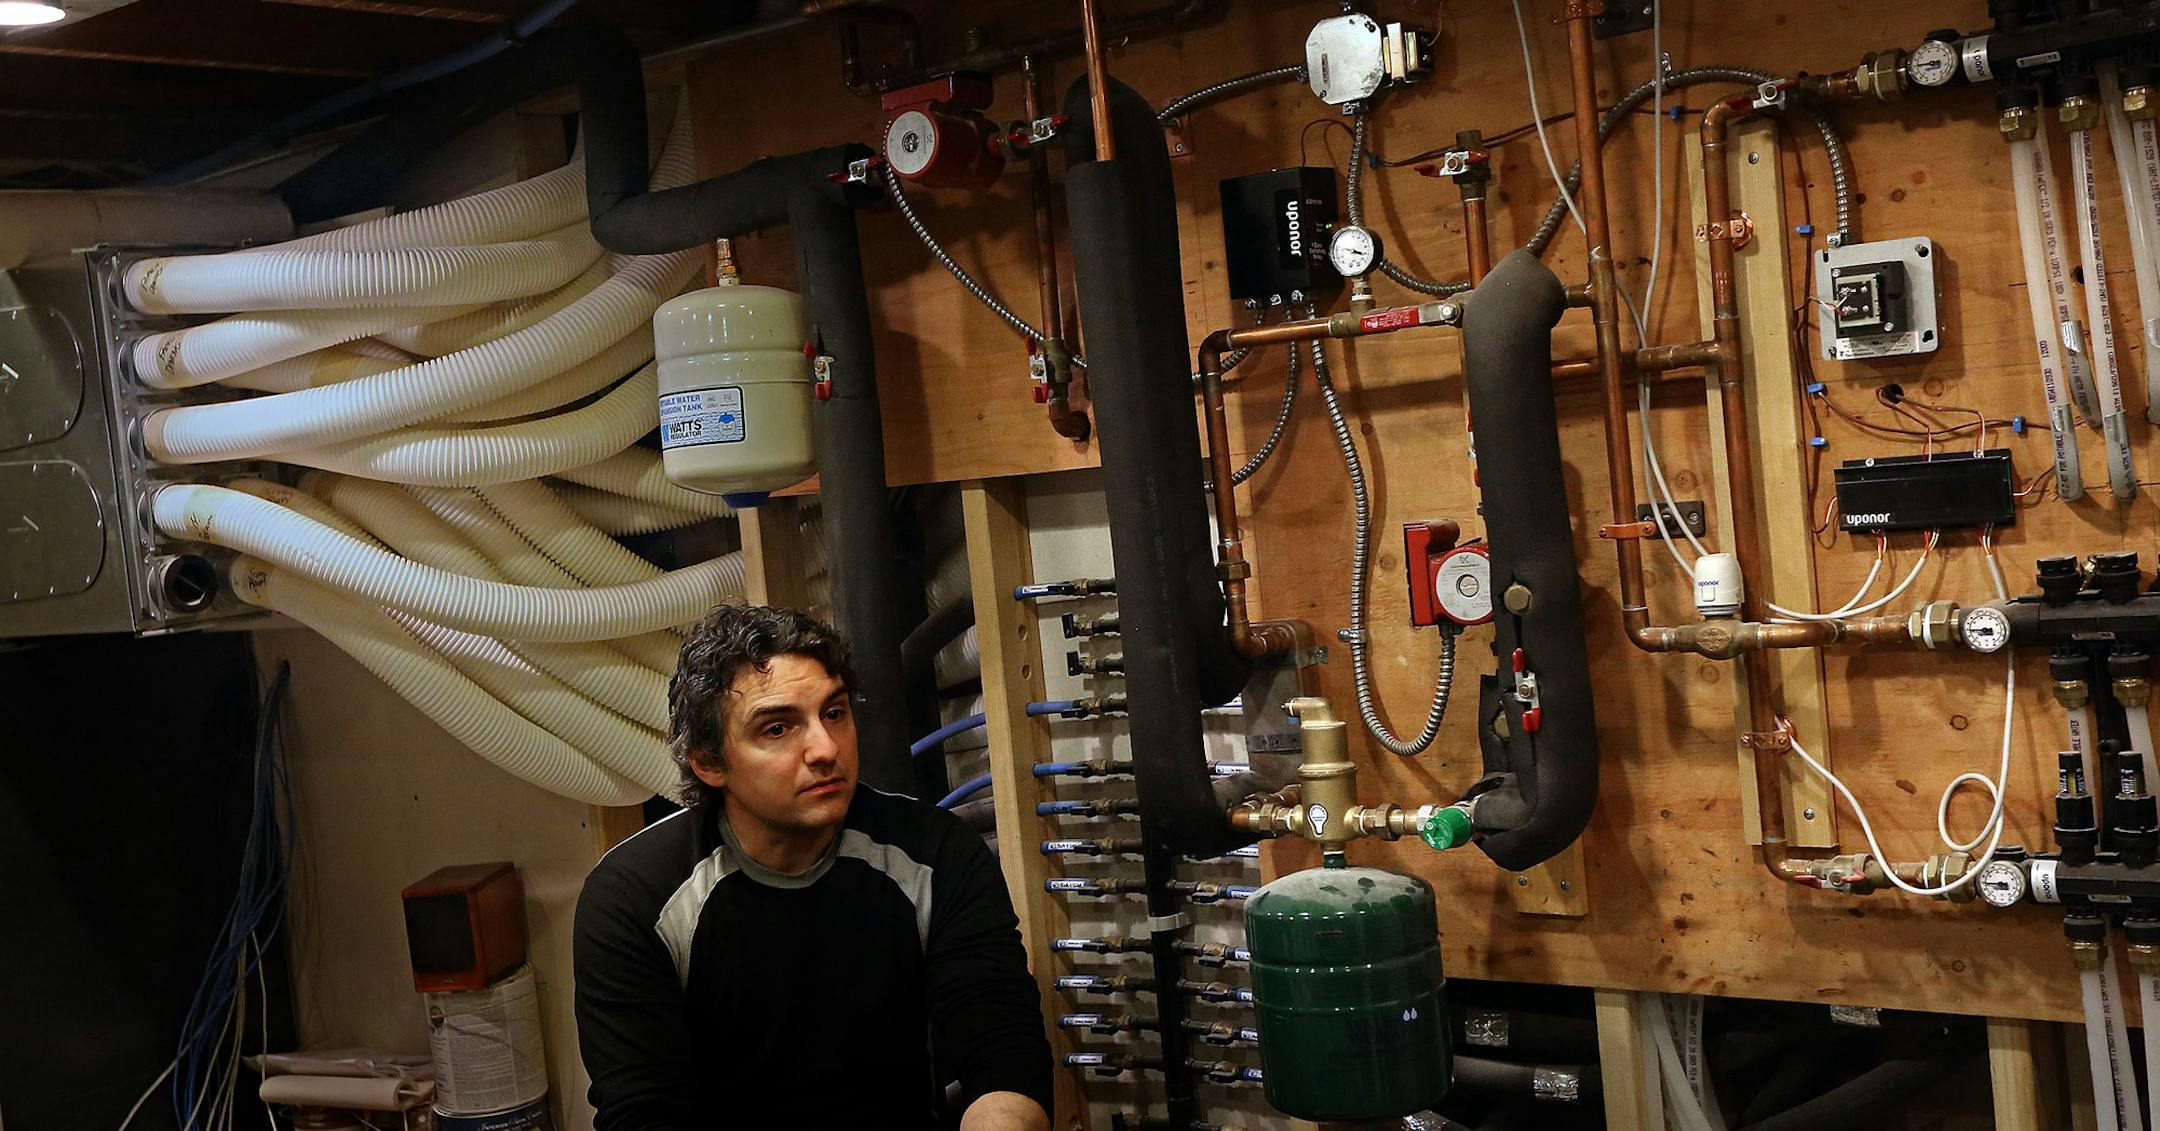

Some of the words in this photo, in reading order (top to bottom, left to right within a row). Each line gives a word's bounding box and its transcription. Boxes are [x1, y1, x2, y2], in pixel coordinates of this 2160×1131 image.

[1286, 201, 1302, 257] uponor
[676, 394, 701, 404] WATER
[683, 403, 703, 412] TANK
[670, 419, 702, 434] WATTS
[670, 431, 702, 440] REGULATOR
[1846, 512, 1890, 525] uponor
[2041, 873, 2053, 900] uponor
